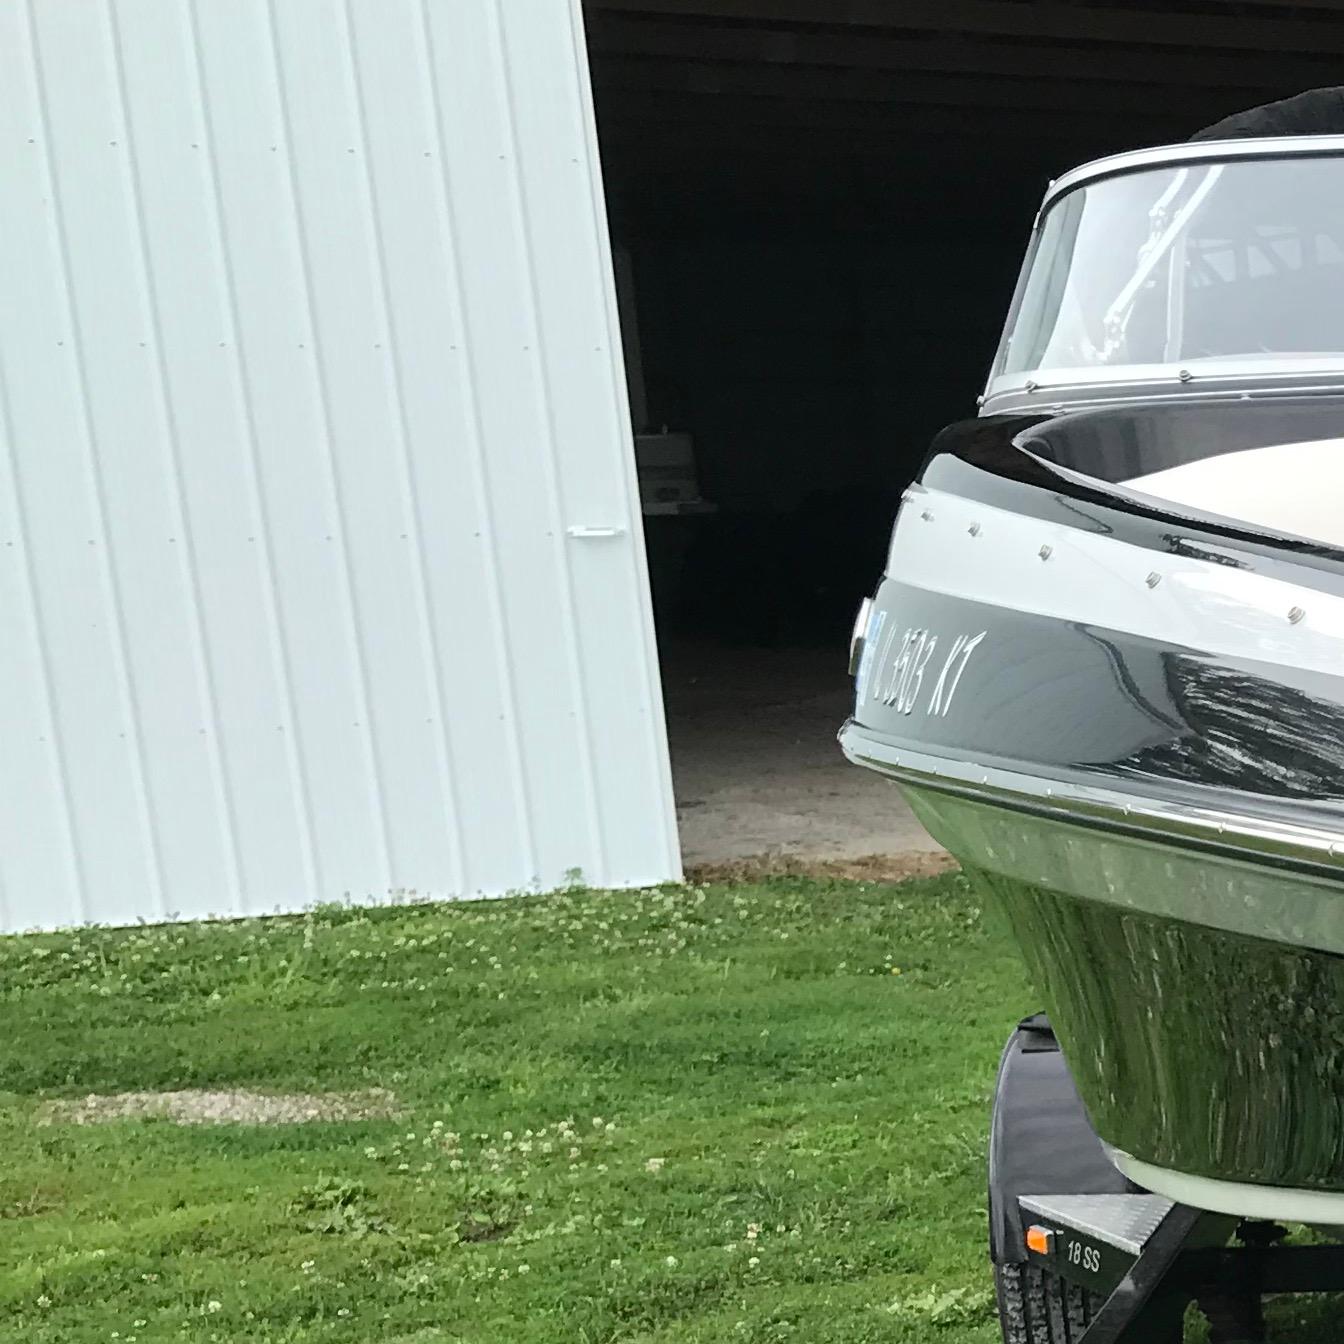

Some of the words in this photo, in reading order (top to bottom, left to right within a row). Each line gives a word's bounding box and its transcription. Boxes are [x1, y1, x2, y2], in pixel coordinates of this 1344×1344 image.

[927, 630, 987, 717] KT
[1067, 1240, 1081, 1265] 18
[1083, 1246, 1101, 1272] SS
